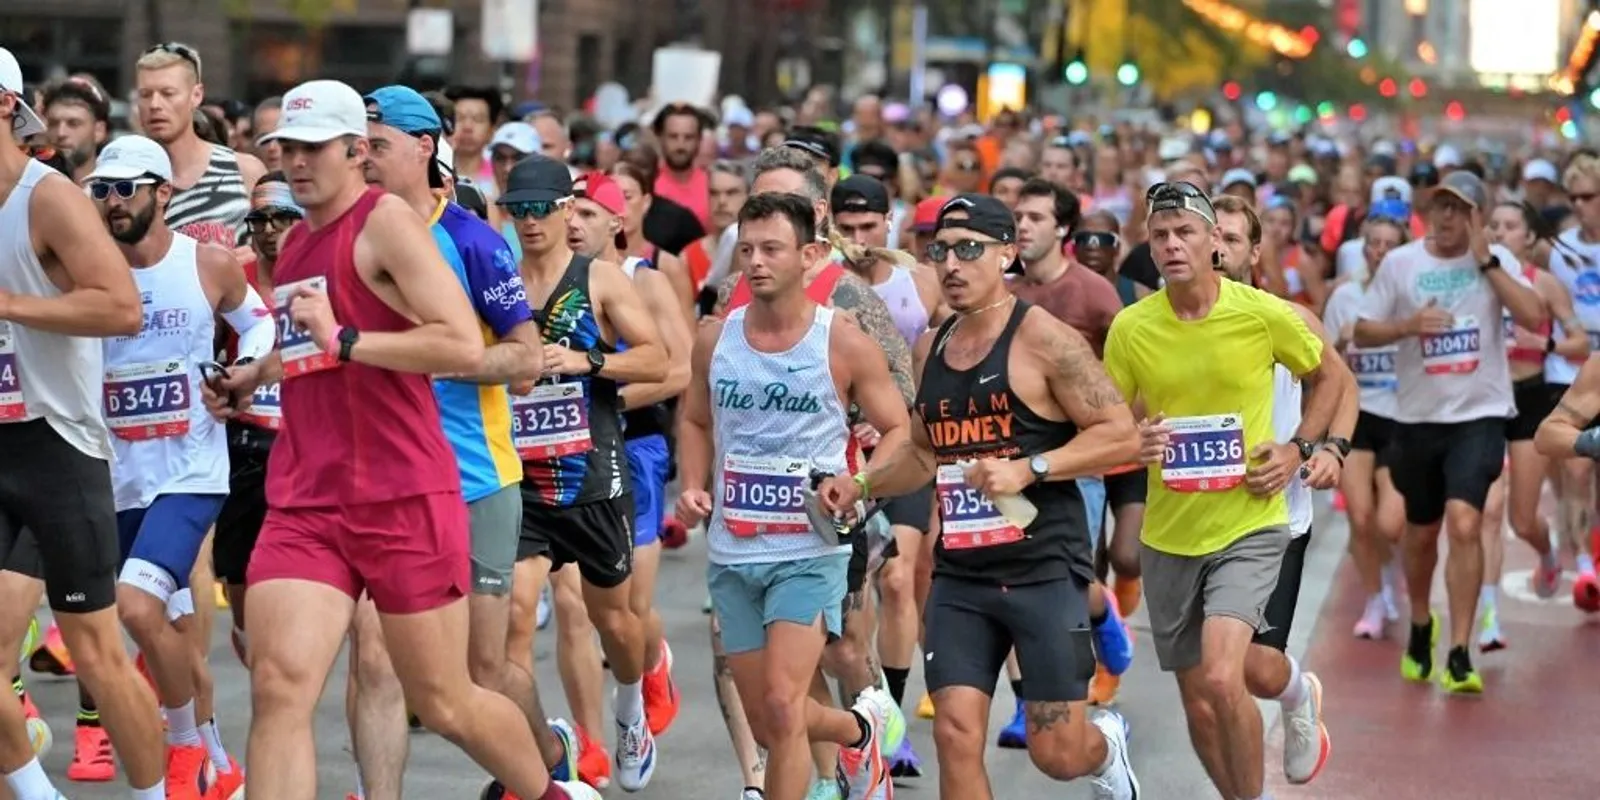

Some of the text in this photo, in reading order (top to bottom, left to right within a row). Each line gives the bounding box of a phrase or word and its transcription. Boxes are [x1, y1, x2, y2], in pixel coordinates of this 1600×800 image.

[109, 381, 185, 412] D3473
[716, 378, 822, 414] The Rats
[919, 392, 1010, 419] TEAM
[513, 403, 582, 433] B3253
[1165, 439, 1243, 464] D11536
[726, 482, 805, 508] D10595
